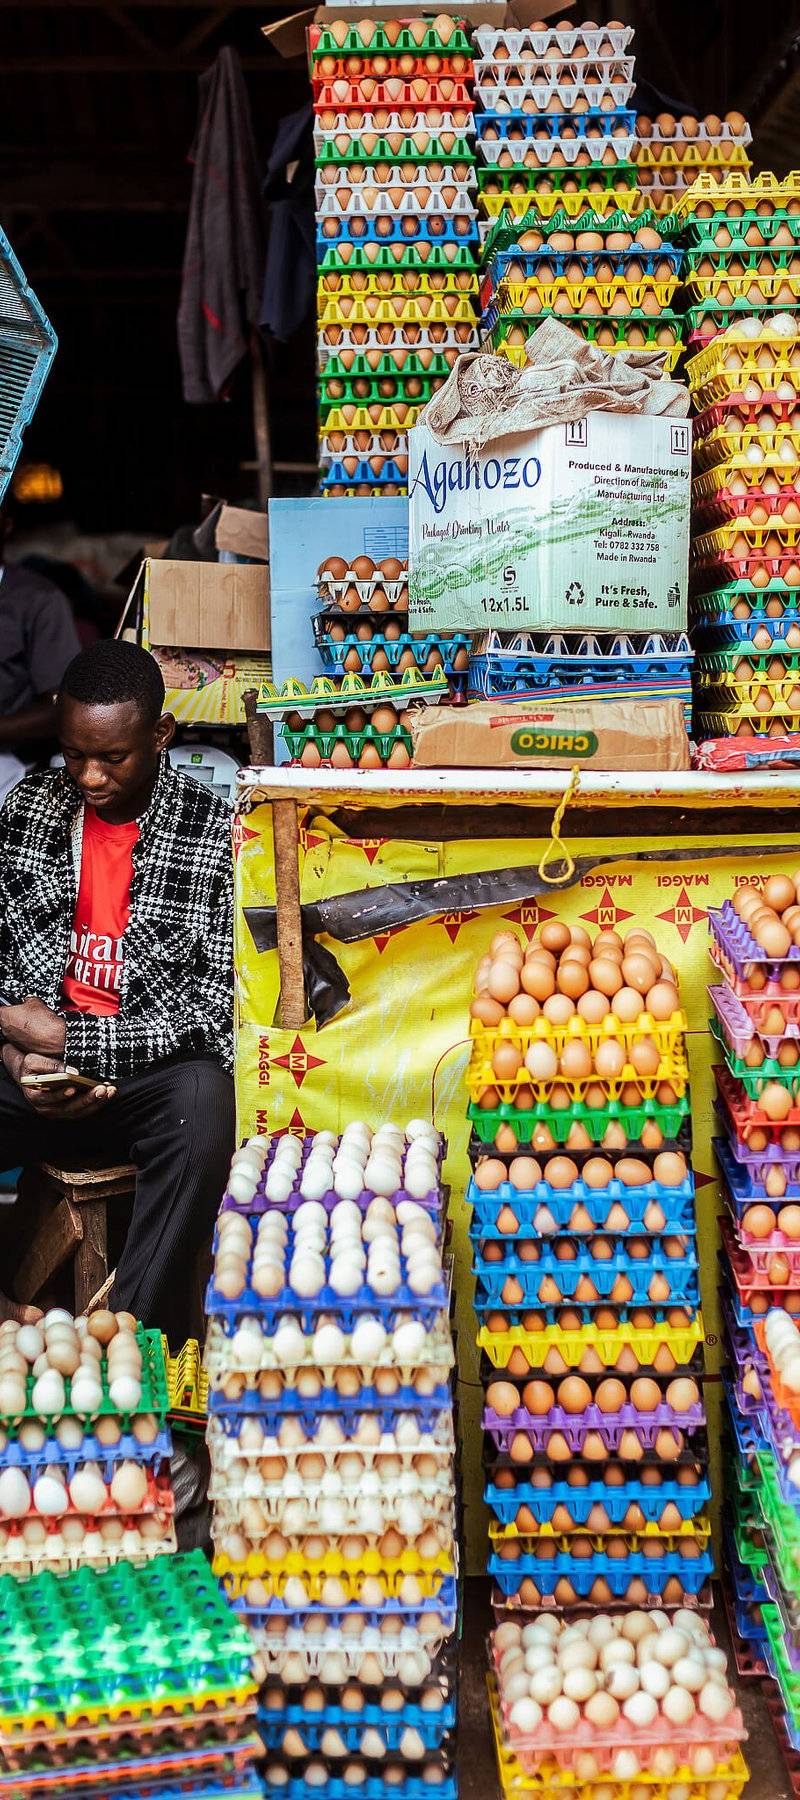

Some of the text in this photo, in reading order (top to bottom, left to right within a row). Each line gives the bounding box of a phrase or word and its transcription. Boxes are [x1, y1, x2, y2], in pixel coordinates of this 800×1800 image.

[568, 460, 690, 479] Produced & Manufactured by
[408, 446, 542, 513] Agahozo
[594, 475, 668, 489] Direction of Rwanda
[597, 489, 665, 503] Manufacturing Ltd
[611, 517, 646, 527] Address:
[422, 518, 510, 542] Packaged Drinking Water
[593, 540, 660, 552] Tel: 0782 332 758
[596, 552, 657, 563] Made in Rwanda
[601, 585, 650, 597] It's Fresh,
[481, 596, 530, 612] 12x1.5L
[595, 597, 658, 609] Pure & Safe.
[518, 733, 589, 751] CHICO
[580, 874, 633, 888] MAGGI
[654, 874, 710, 887] MAGGI
[732, 874, 774, 888] AGGI
[522, 909, 537, 922] M
[600, 909, 614, 922] M
[677, 909, 691, 922] M
[75, 958, 124, 990] BETTE
[258, 1034, 270, 1089] MAGGI
[291, 1055, 306, 1069] M
